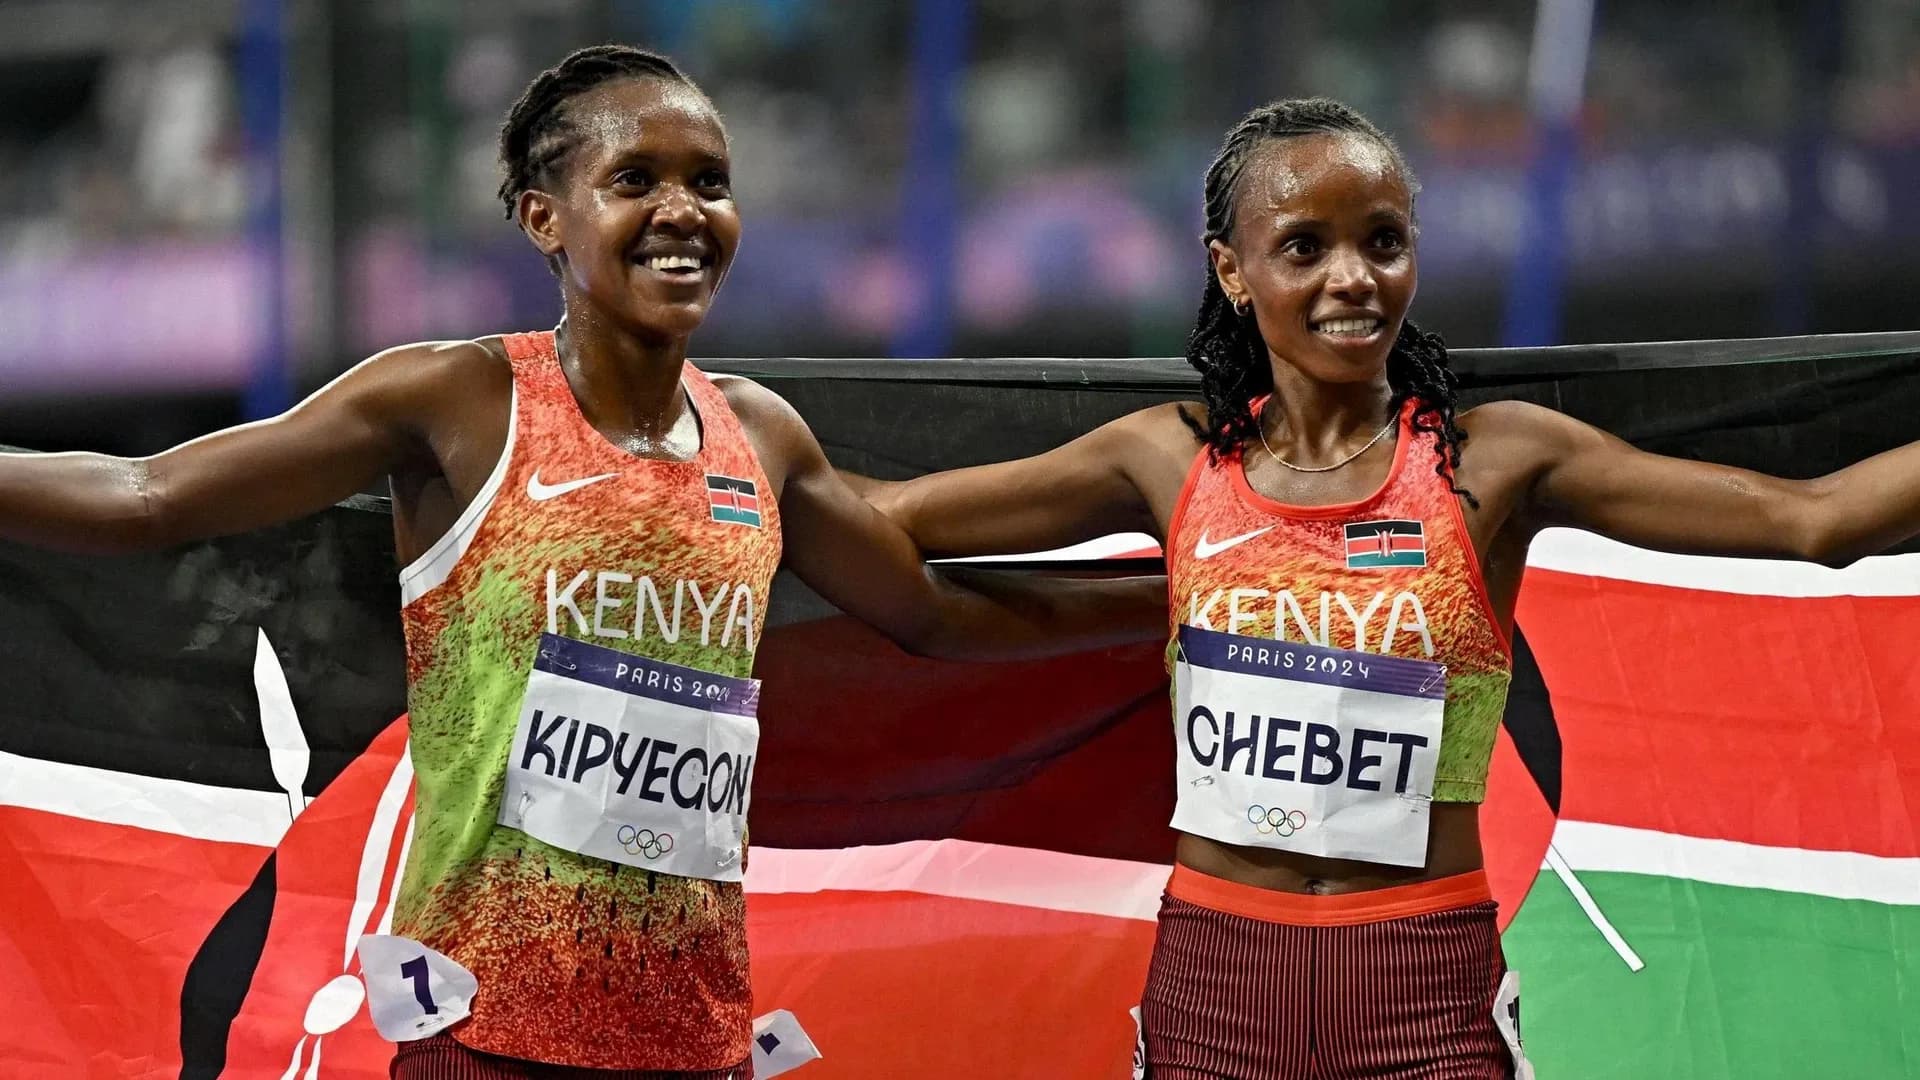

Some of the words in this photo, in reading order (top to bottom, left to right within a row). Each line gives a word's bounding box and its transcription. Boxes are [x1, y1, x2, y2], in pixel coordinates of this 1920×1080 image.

[546, 569, 755, 652] KENYA
[1189, 588, 1435, 657] KENYA
[1305, 655, 1370, 679] 2024
[520, 709, 752, 816] KIPYEGON
[1186, 704, 1429, 794] CHEBET
